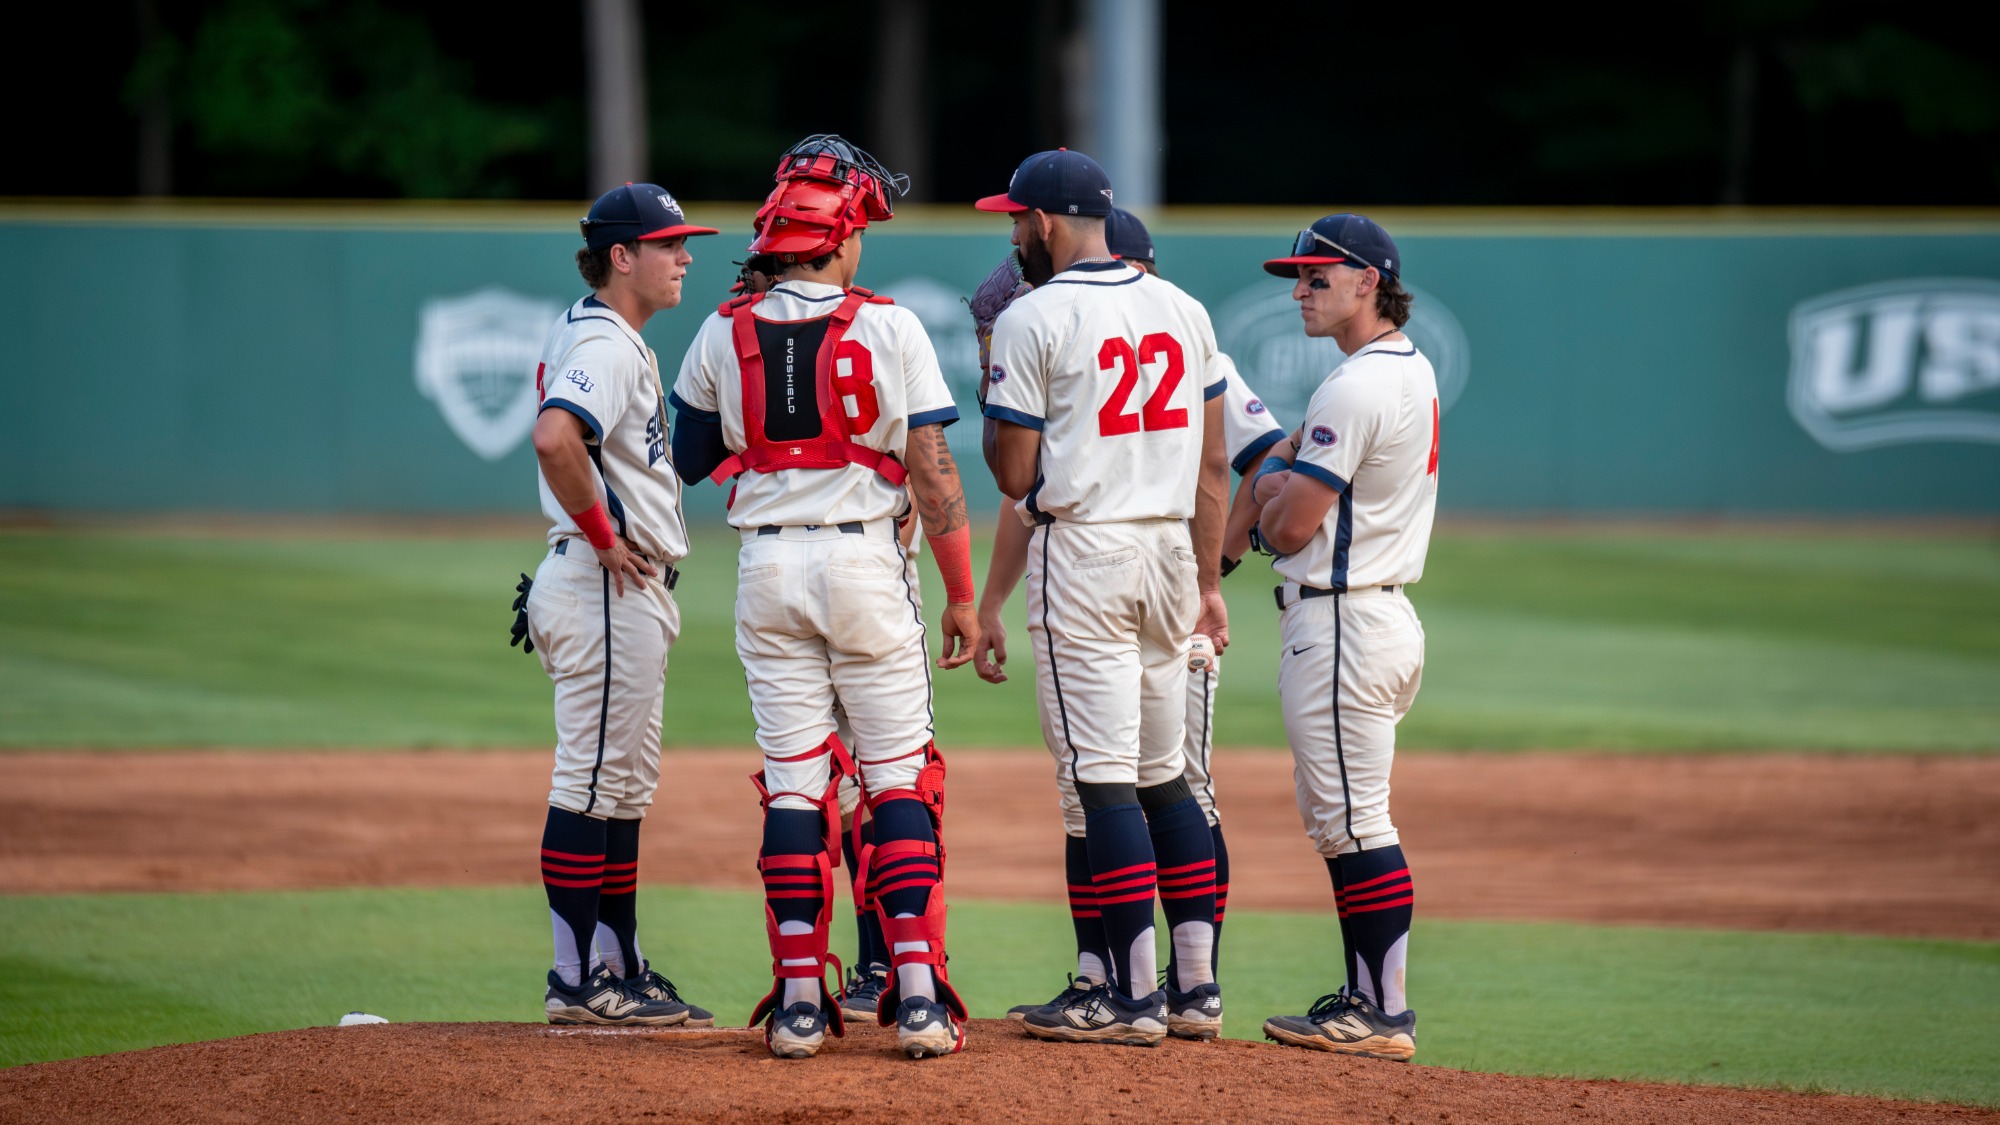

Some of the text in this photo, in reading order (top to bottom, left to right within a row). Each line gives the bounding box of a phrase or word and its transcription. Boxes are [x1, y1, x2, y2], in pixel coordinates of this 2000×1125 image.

[566, 369, 595, 393] USI
[786, 338, 796, 414] EVOSHIELD
[1098, 332, 1188, 437] 22
